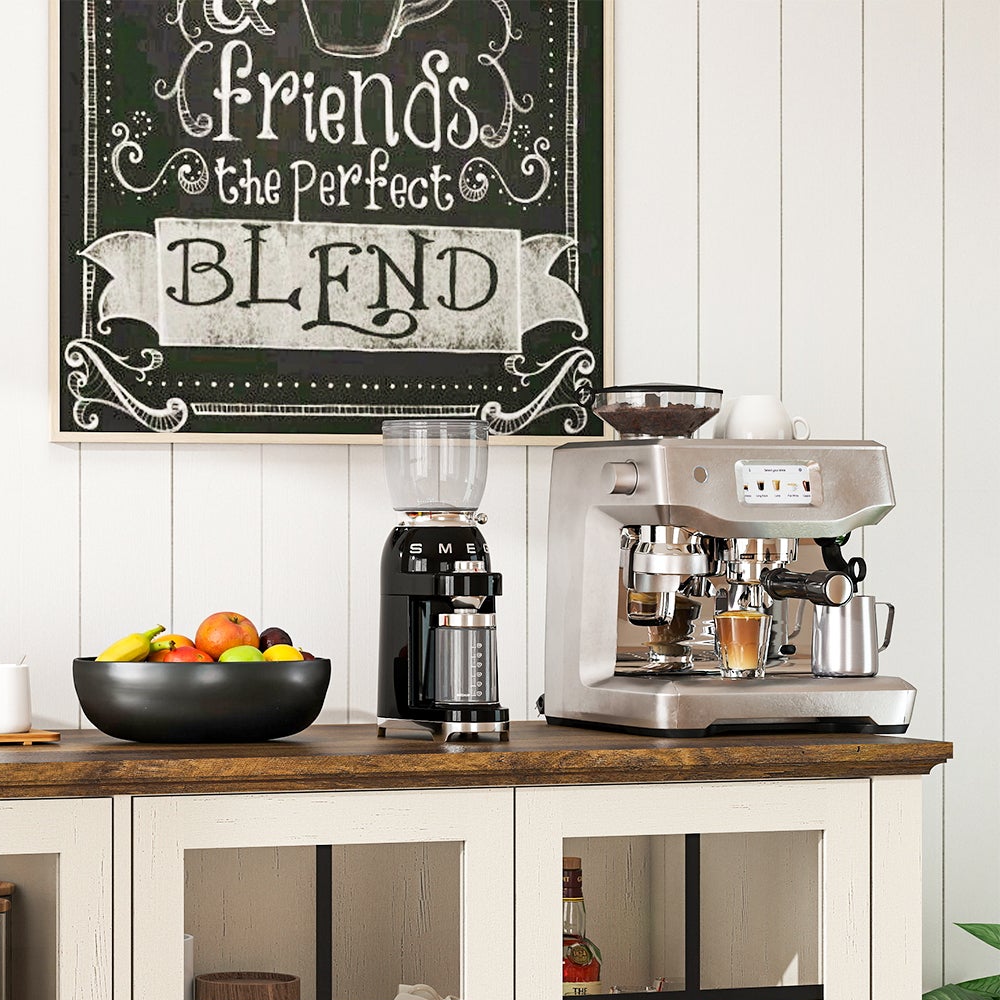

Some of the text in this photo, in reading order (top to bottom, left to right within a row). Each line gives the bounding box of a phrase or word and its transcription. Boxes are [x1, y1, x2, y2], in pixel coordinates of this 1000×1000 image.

[212, 40, 482, 152] friends
[213, 149, 455, 223] the perfect
[166, 223, 498, 339] BLEND
